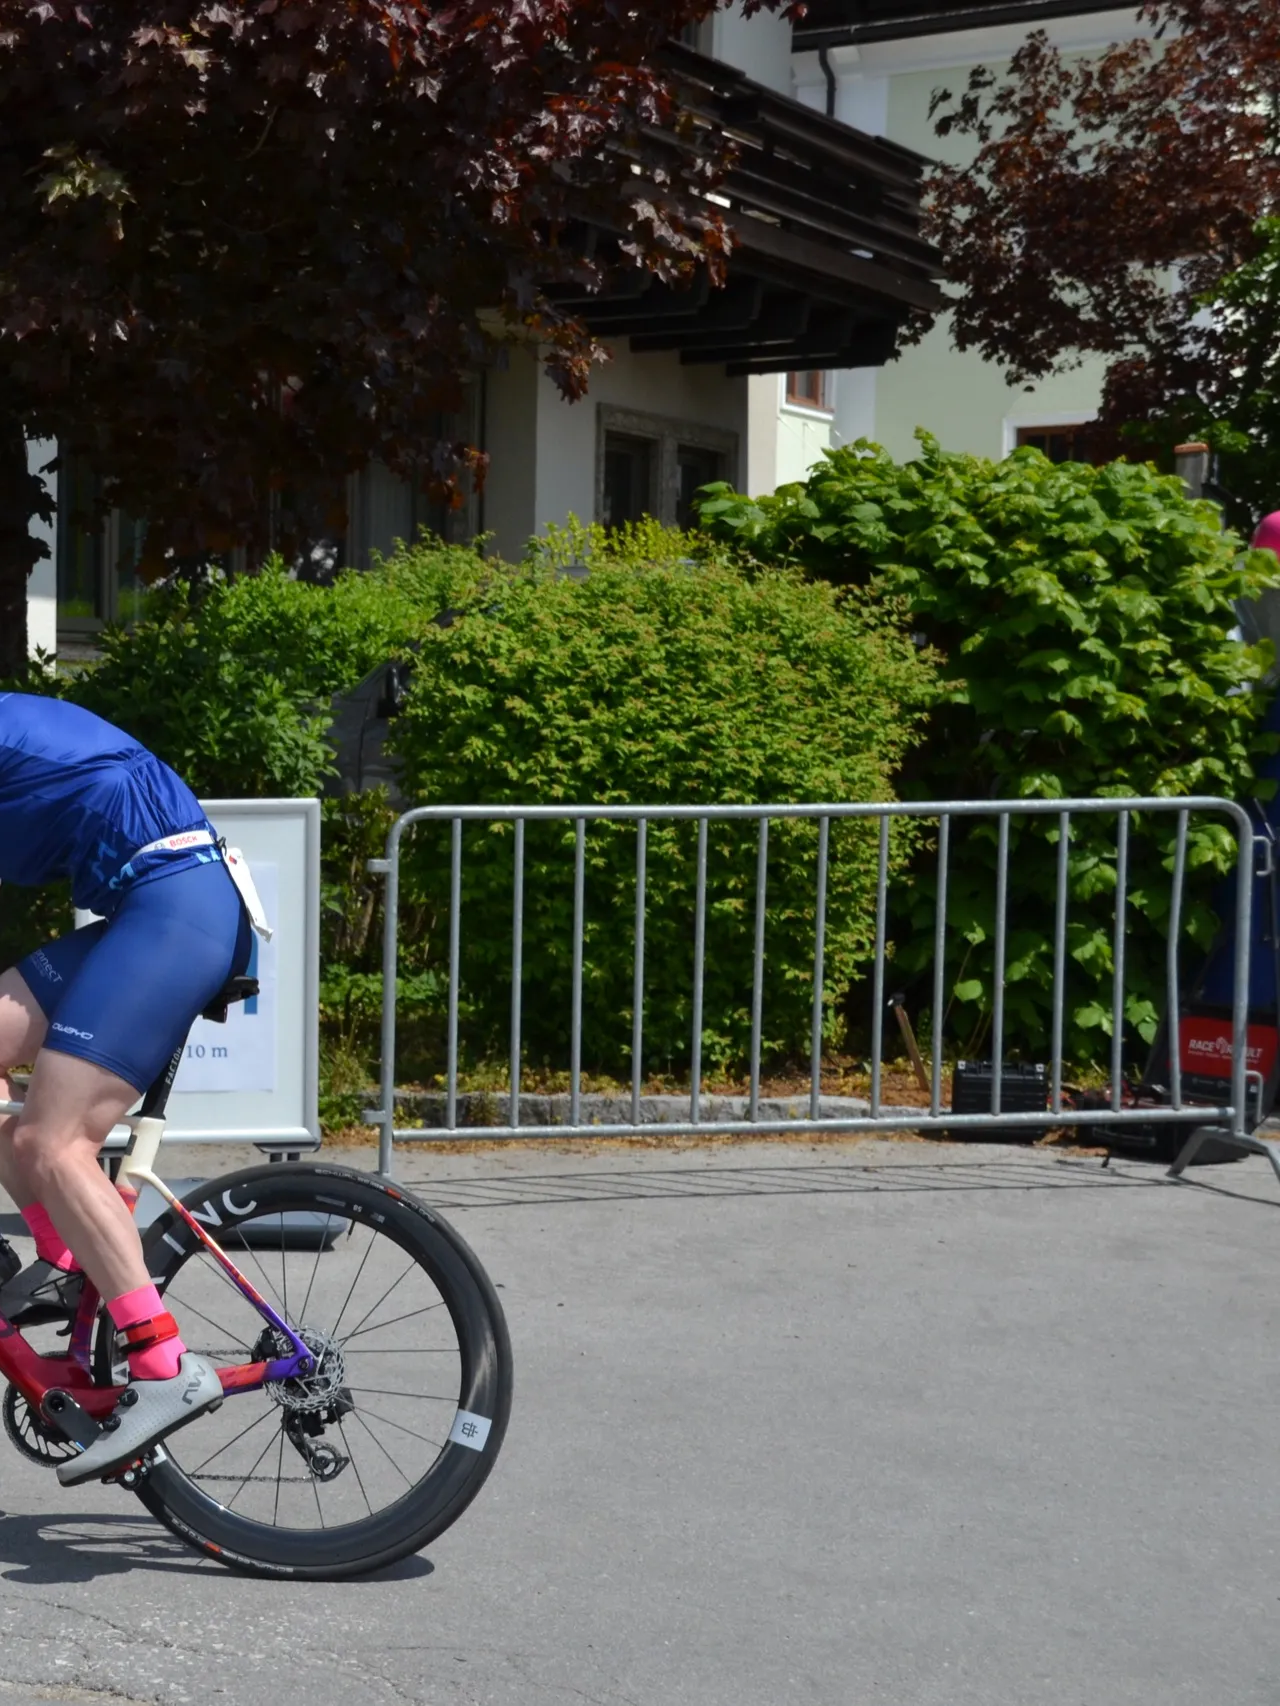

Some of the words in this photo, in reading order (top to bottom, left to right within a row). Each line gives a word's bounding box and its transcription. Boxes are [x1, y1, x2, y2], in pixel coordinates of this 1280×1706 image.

[186, 1044, 206, 1058] 10
[211, 1047, 228, 1058] m
[1188, 1039, 1215, 1052] RACE
